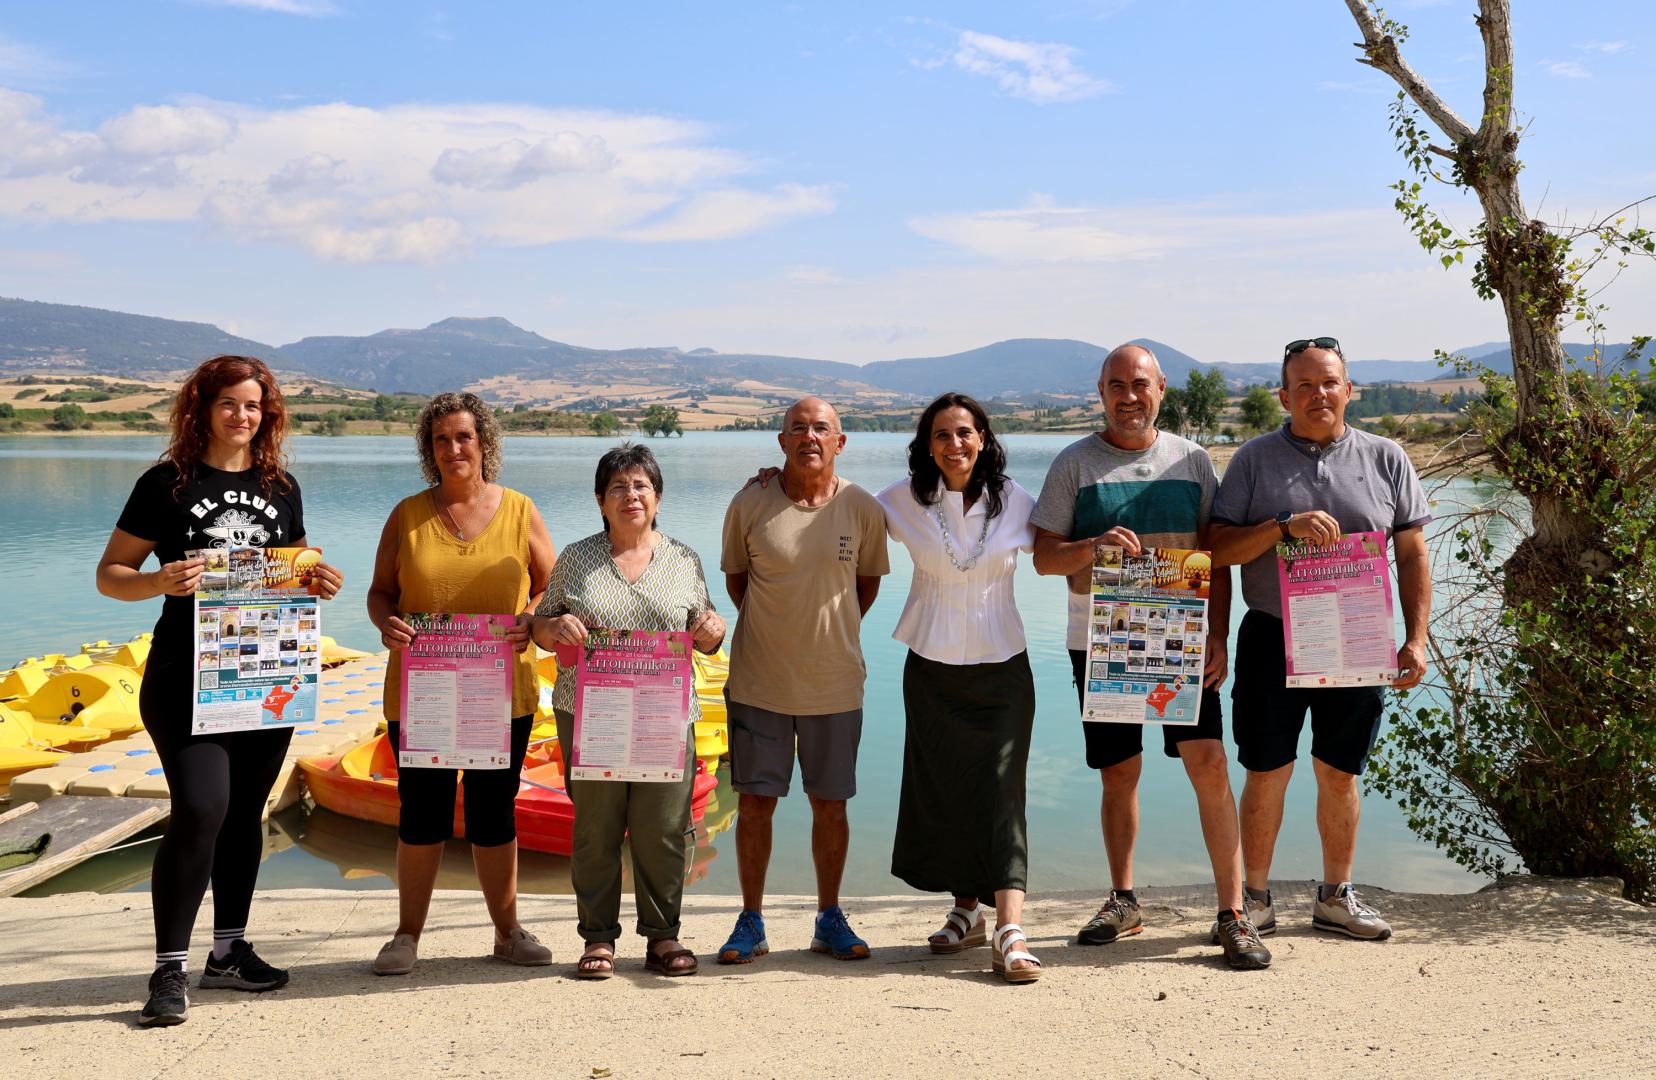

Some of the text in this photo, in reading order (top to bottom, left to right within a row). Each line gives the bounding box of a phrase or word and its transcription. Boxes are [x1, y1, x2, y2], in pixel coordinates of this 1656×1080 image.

[190, 490, 279, 520] EL CLUB
[71, 685, 81, 698] 6
[119, 679, 134, 695] 6
